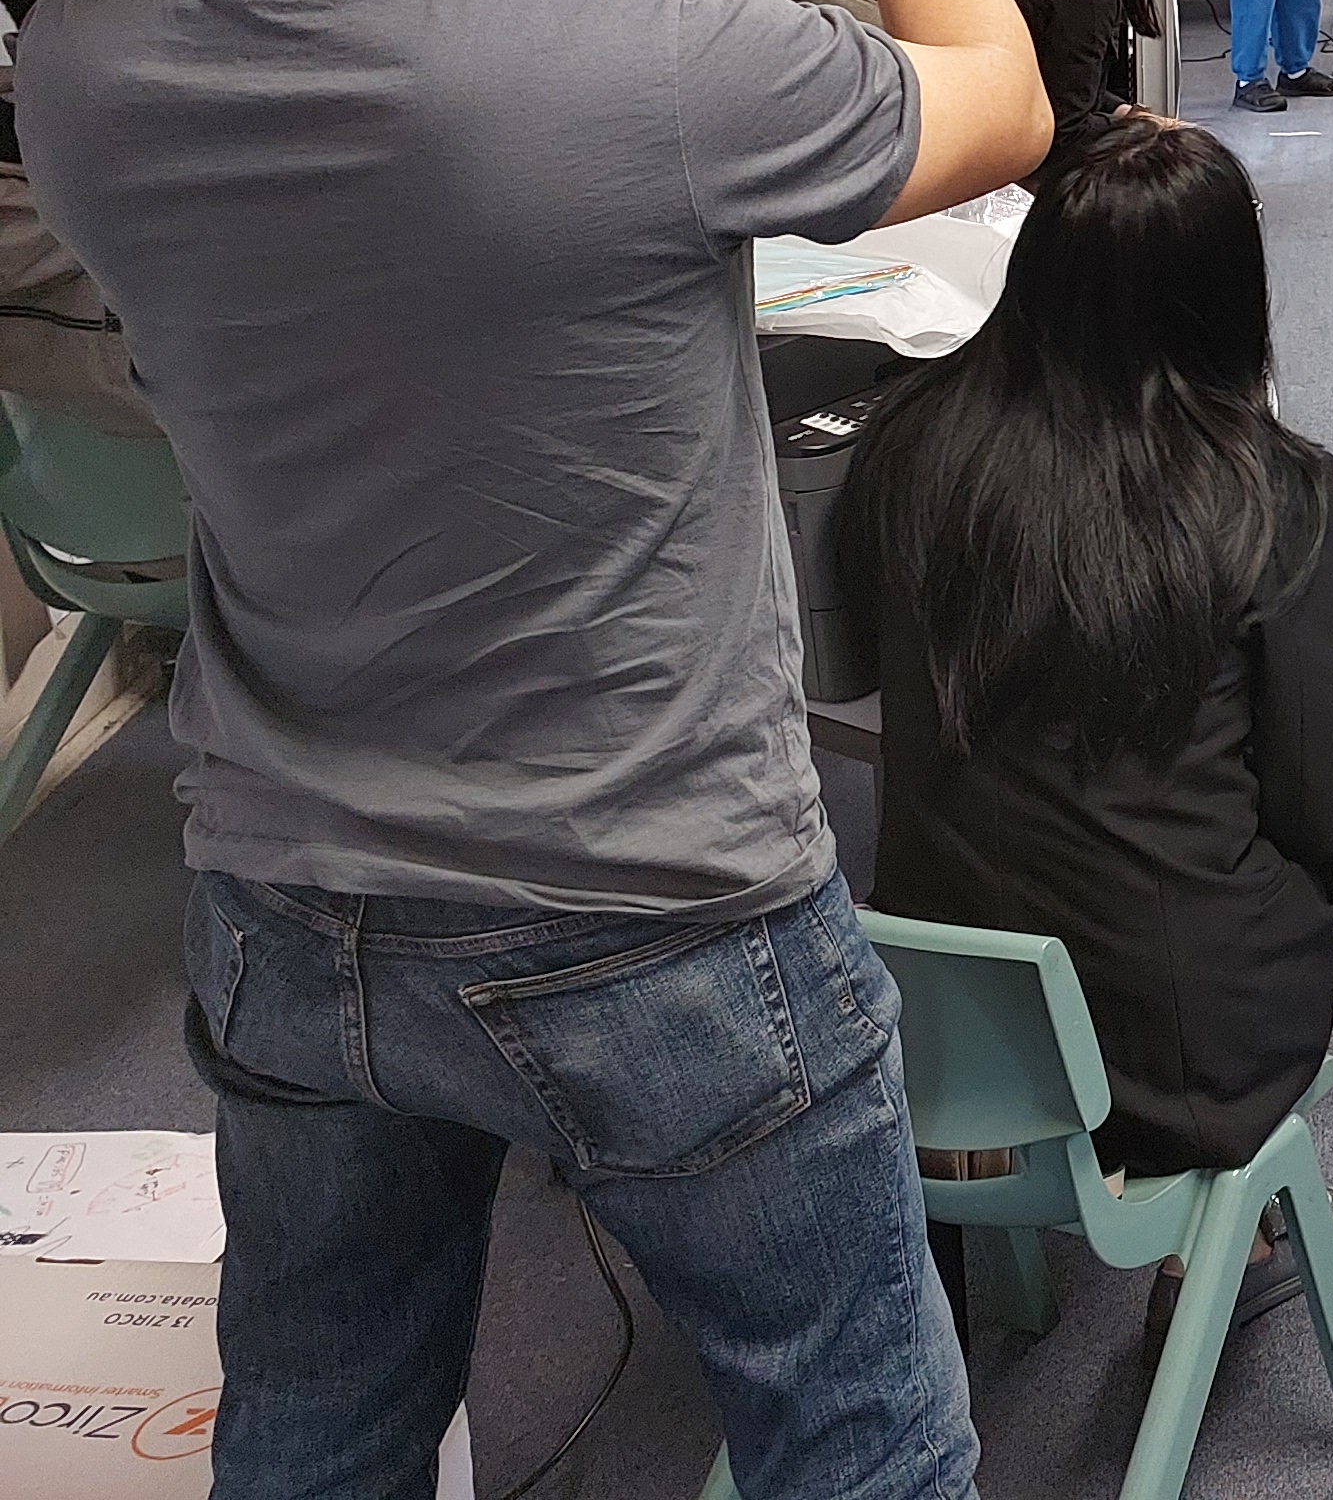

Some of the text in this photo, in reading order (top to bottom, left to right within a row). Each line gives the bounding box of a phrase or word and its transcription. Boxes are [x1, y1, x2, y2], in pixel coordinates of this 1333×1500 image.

[103, 1313, 195, 1328] 13 ZIRCO
[9, 1382, 165, 1398] Smarter information
